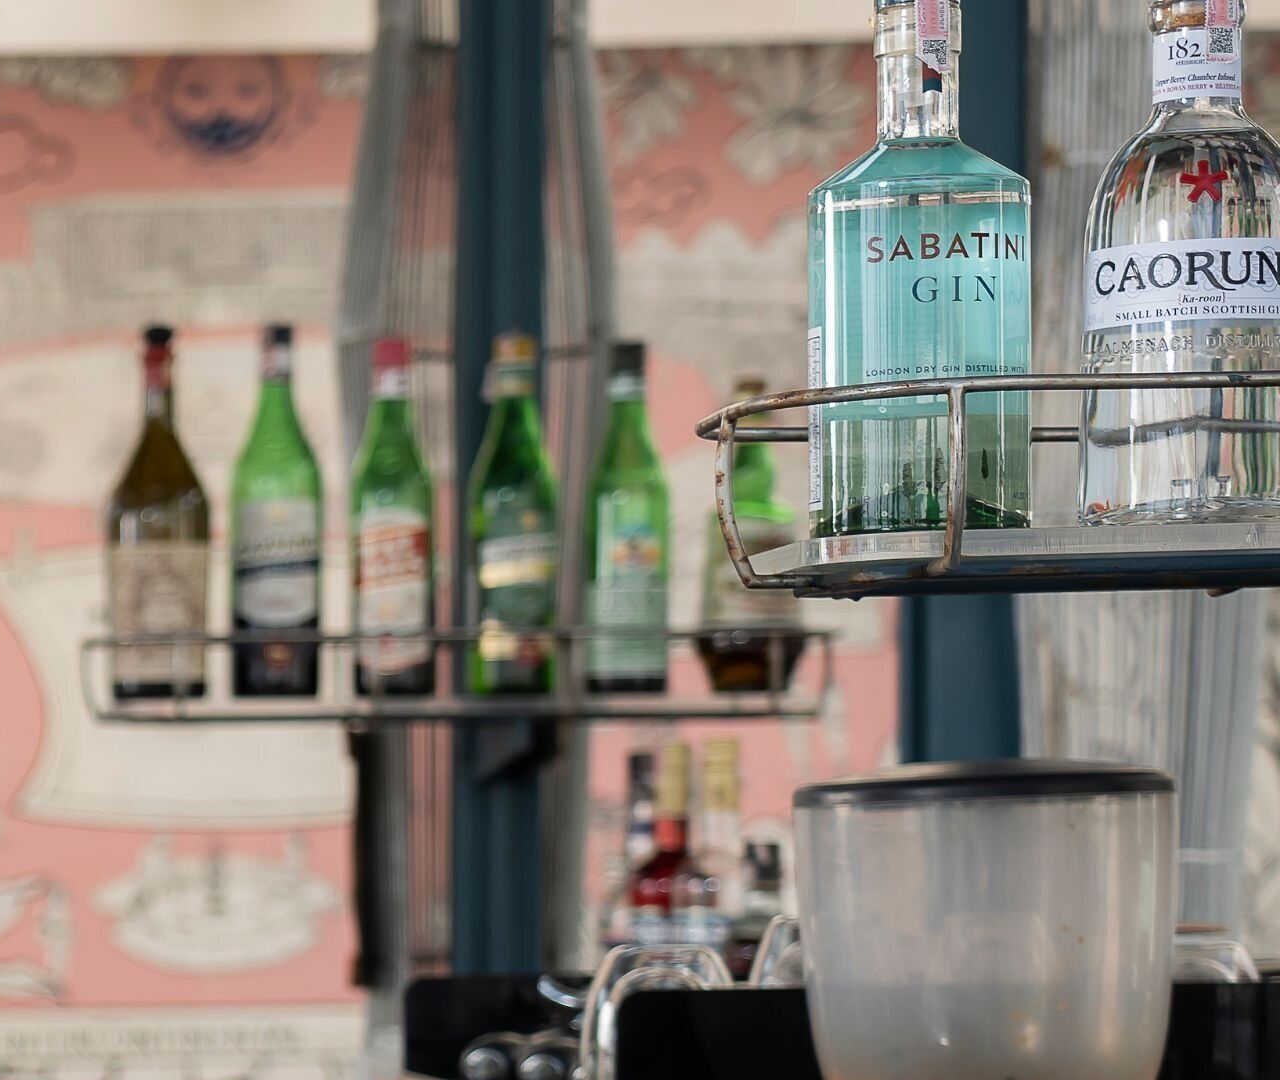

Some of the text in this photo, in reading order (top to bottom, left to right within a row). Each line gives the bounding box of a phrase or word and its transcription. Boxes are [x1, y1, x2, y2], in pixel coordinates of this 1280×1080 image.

[1168, 38, 1206, 60] 182
[1170, 76, 1186, 85] Berry
[1187, 72, 1216, 82] Chamber
[1217, 72, 1236, 81] Infused
[867, 232, 1025, 264] SABATINI
[1095, 250, 1280, 296] CAORUN
[912, 275, 997, 303] GIN
[1115, 312, 1152, 322] SMALL
[1155, 306, 1198, 318] BATCH
[1202, 305, 1265, 315] SCOTTISH
[1268, 305, 1280, 314] GI
[866, 367, 910, 377] LONDON
[916, 365, 936, 373] DRY
[942, 365, 960, 373] GIN
[965, 364, 1008, 373] DISTILLED
